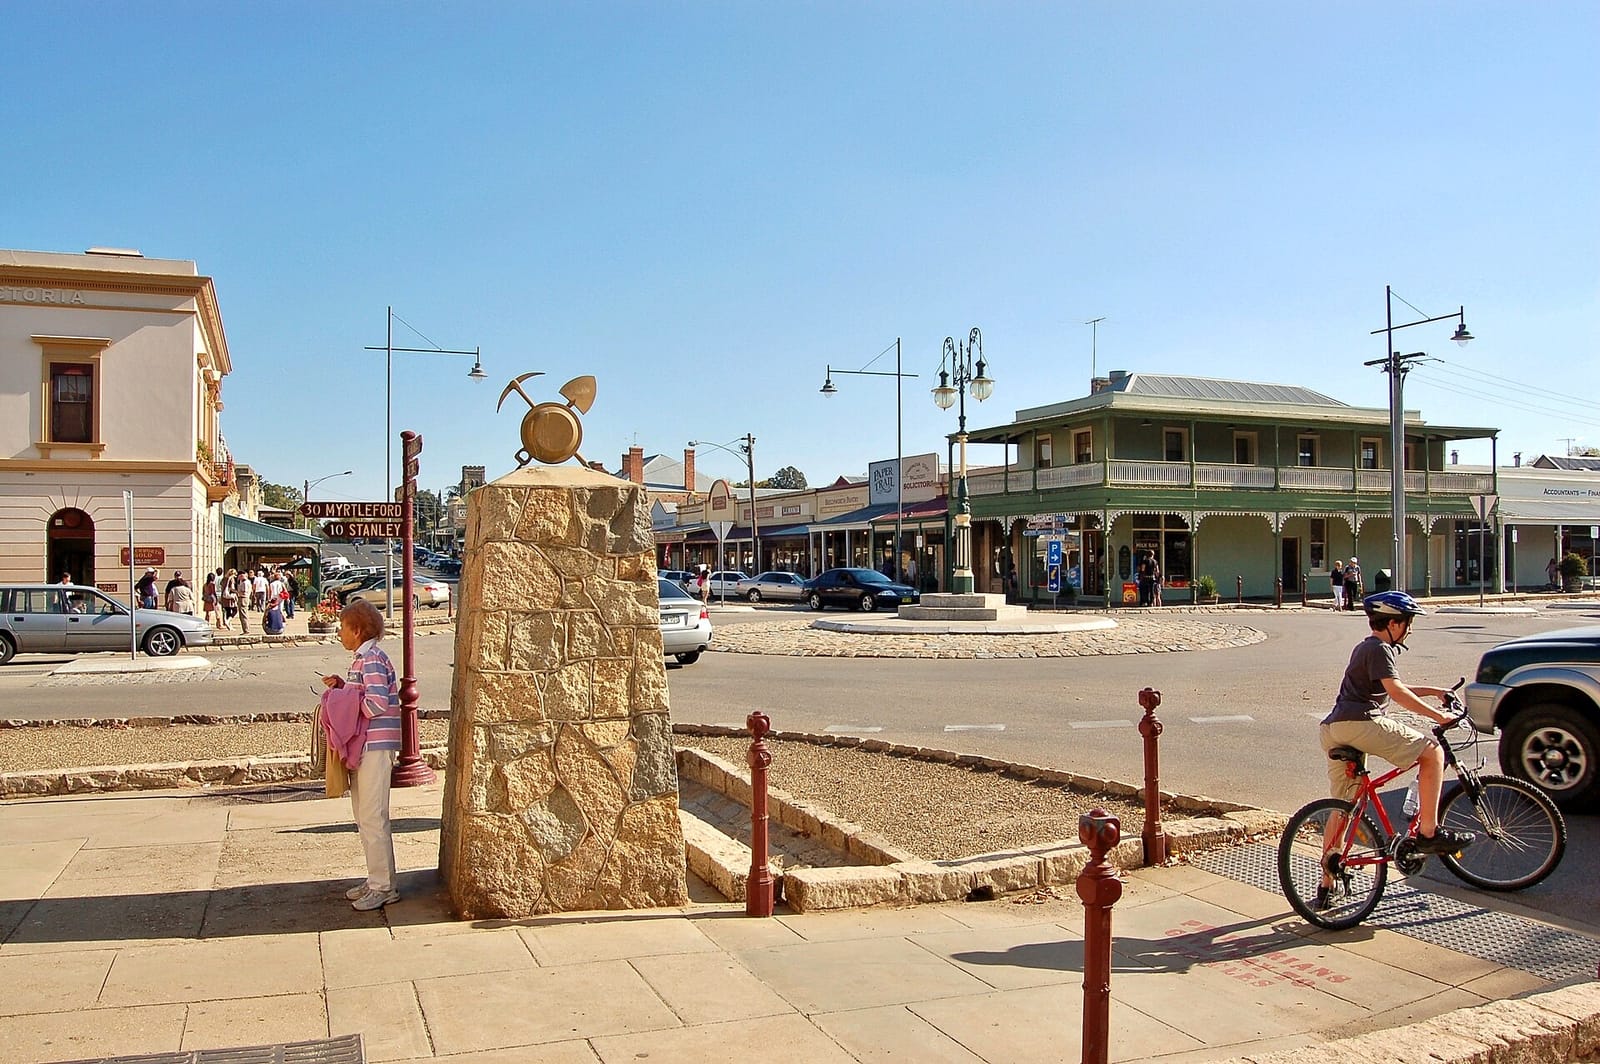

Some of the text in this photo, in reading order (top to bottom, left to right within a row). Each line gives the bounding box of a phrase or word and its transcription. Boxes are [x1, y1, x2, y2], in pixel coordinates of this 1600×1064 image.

[874, 467, 894, 481] PAPER
[874, 477, 895, 492] TRAIL
[1543, 488, 1579, 496] ACCOUNTANTS
[305, 503, 402, 517] 30 MYRTLEFORD
[330, 523, 401, 537] 10 STANLEY
[1051, 544, 1058, 552] P
